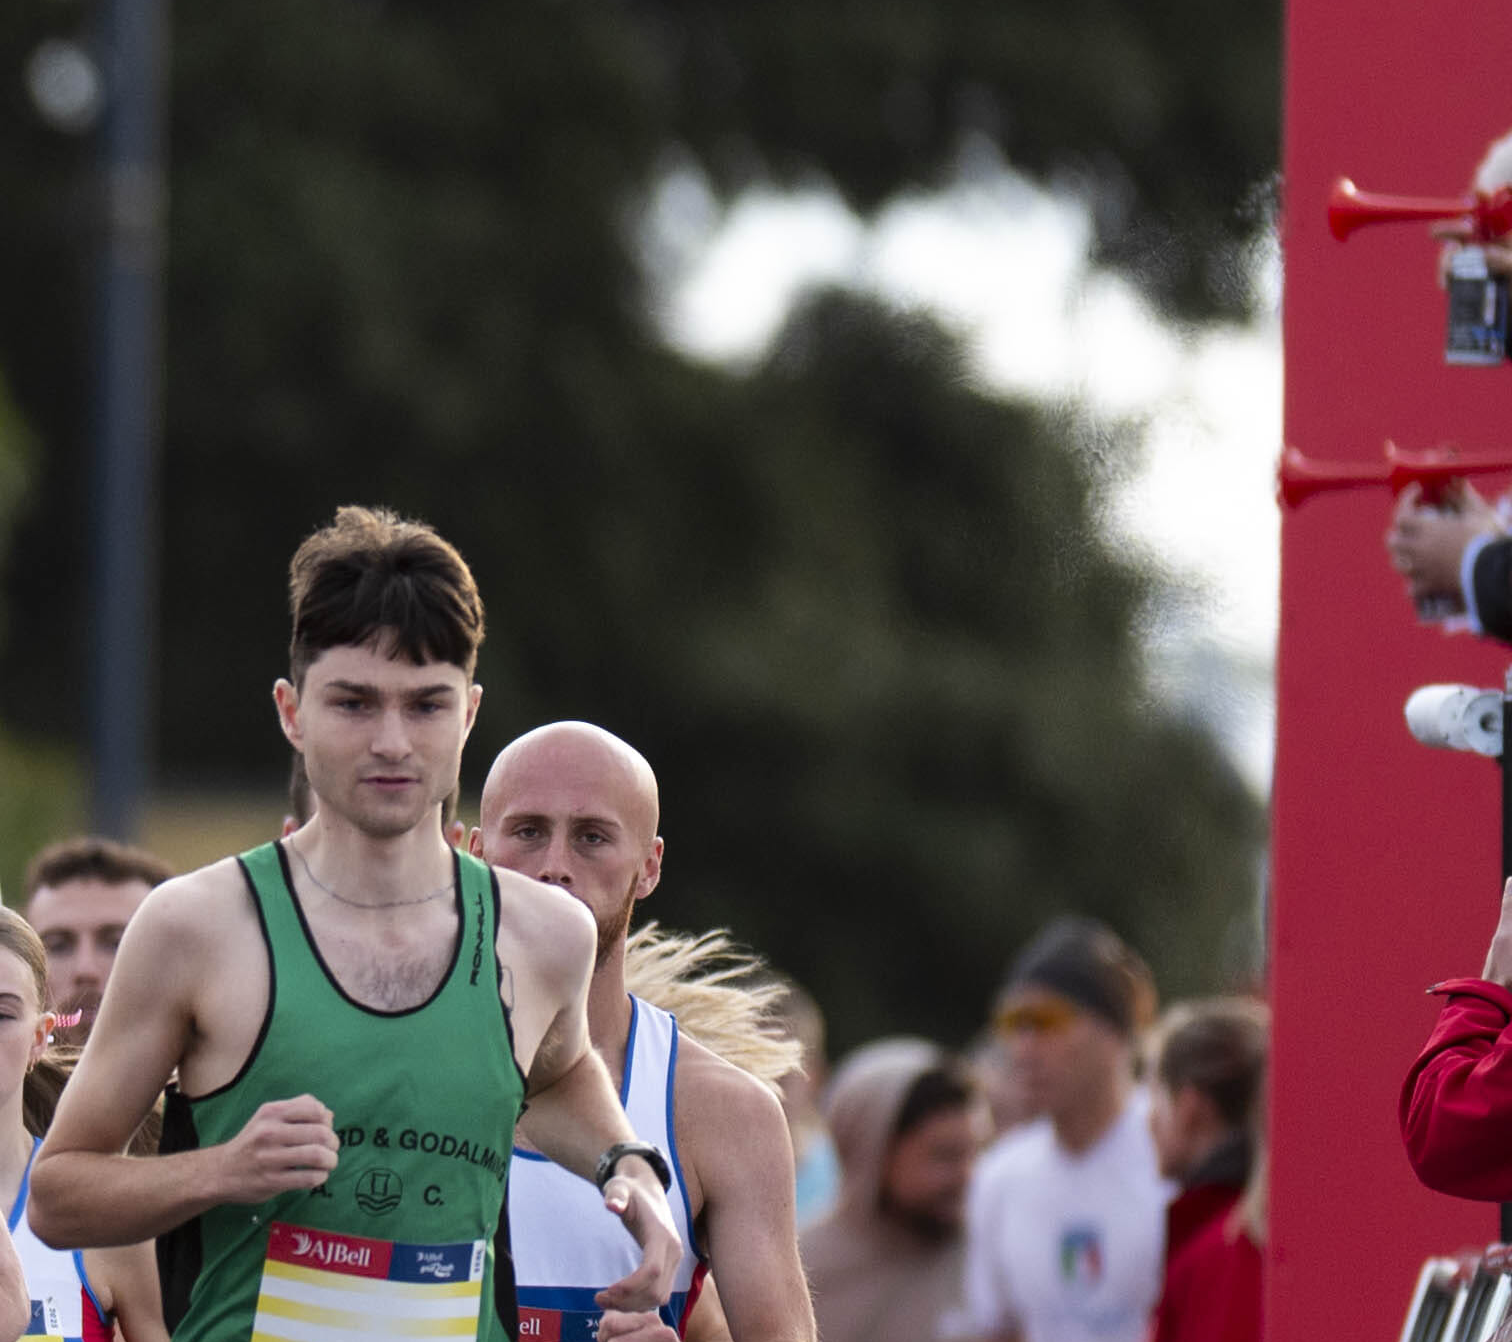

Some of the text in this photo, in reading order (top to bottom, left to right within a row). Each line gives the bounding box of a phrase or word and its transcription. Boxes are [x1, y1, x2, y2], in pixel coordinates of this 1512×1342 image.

[373, 1127, 390, 1148] &
[422, 1184, 445, 1206] C.
[310, 1242, 371, 1267] AJBell
